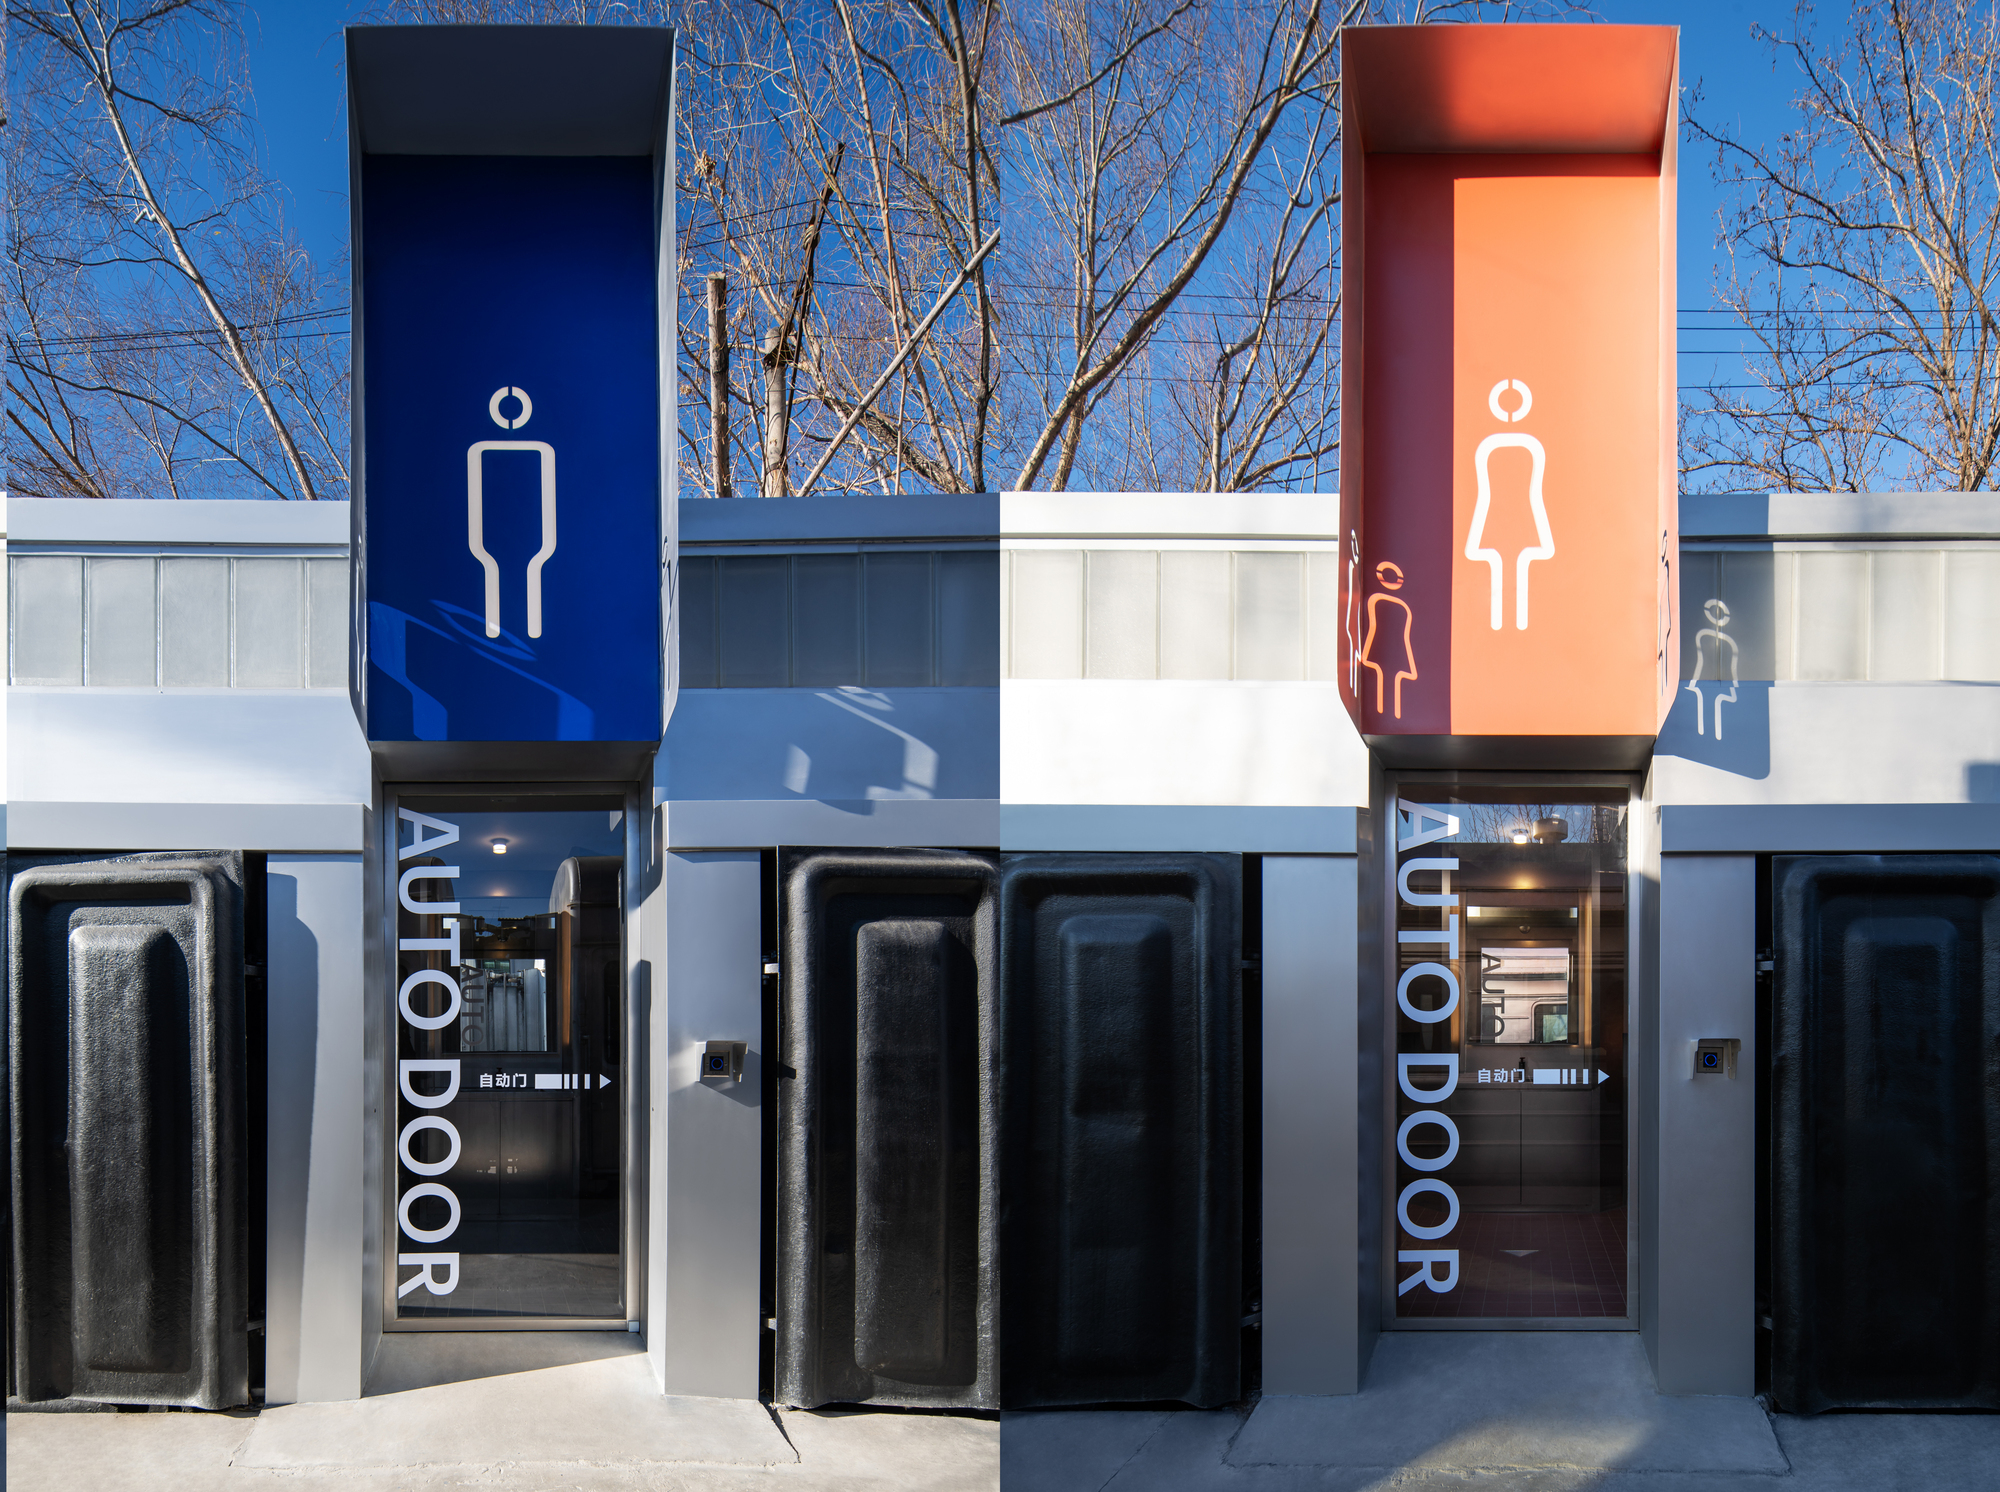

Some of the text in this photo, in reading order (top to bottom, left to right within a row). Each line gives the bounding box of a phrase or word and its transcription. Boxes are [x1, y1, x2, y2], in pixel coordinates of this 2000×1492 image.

[461, 963, 485, 1046] AUTO
[398, 807, 461, 1298] AUTO DOOR
[479, 1073, 527, 1089] 自动门
[1397, 798, 1460, 1297] AUTO DOOR
[1477, 1068, 1526, 1084] 自动门
